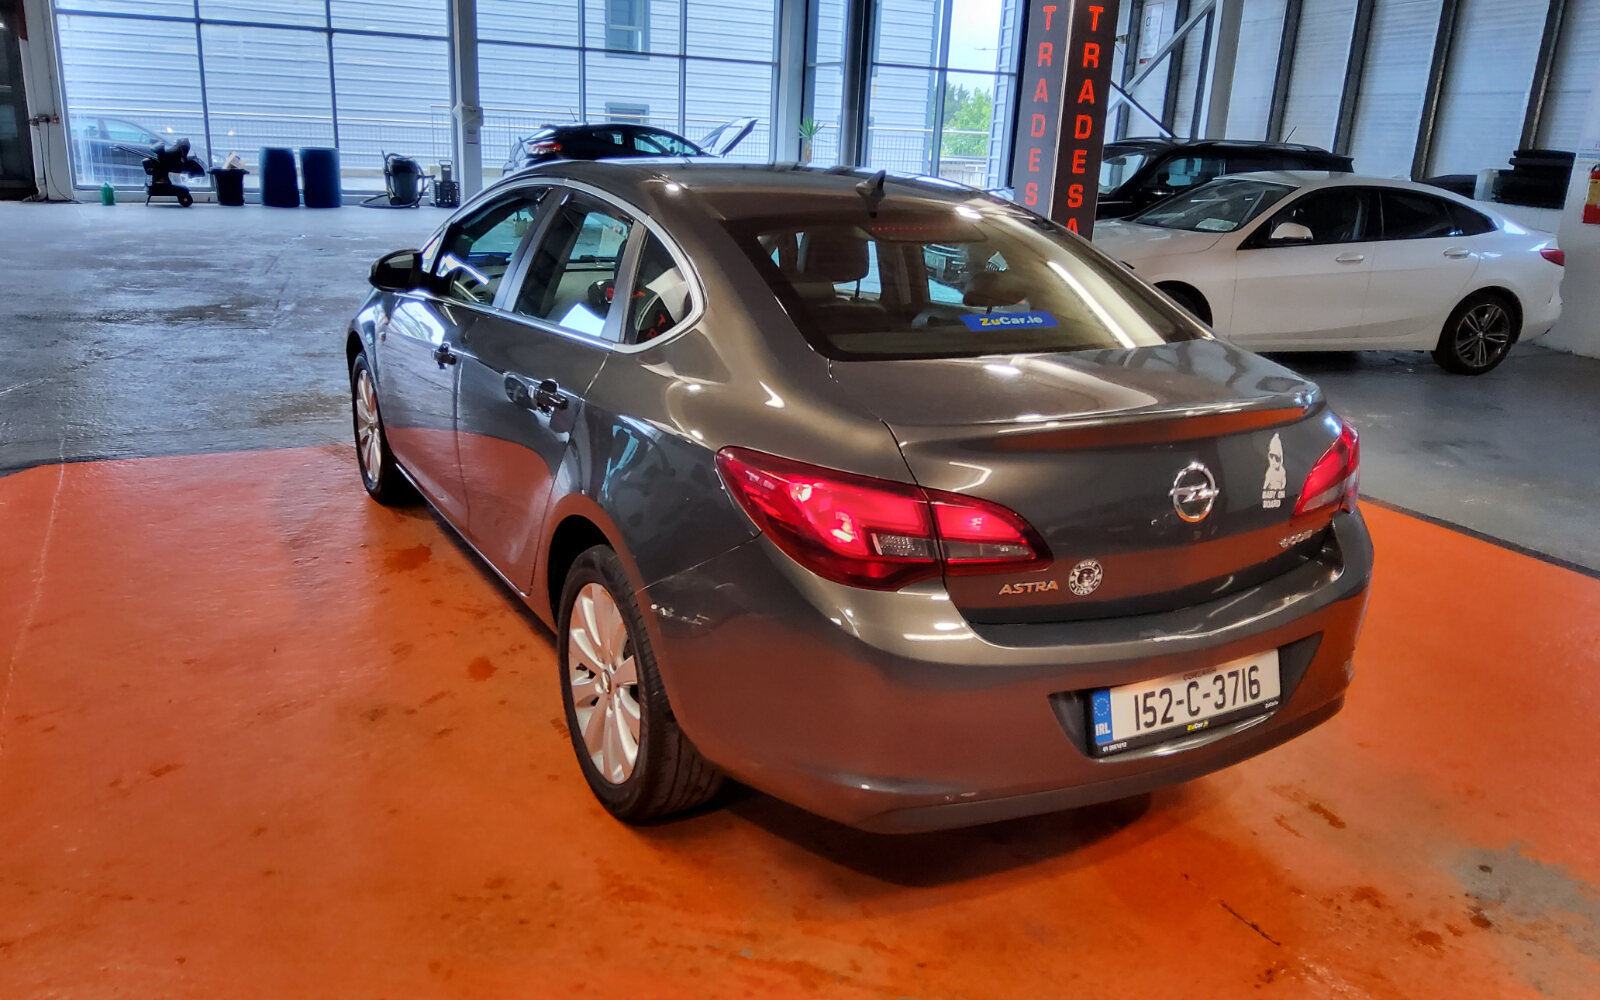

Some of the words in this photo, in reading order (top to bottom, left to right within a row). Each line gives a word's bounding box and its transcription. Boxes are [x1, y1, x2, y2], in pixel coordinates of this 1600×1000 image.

[1025, 5, 1057, 206] TRADES
[978, 315, 1044, 327] ZuCar.ie
[998, 580, 1059, 596] ASTRA
[1133, 664, 1261, 731] 152-C-3716
[1095, 721, 1111, 737] IRL
